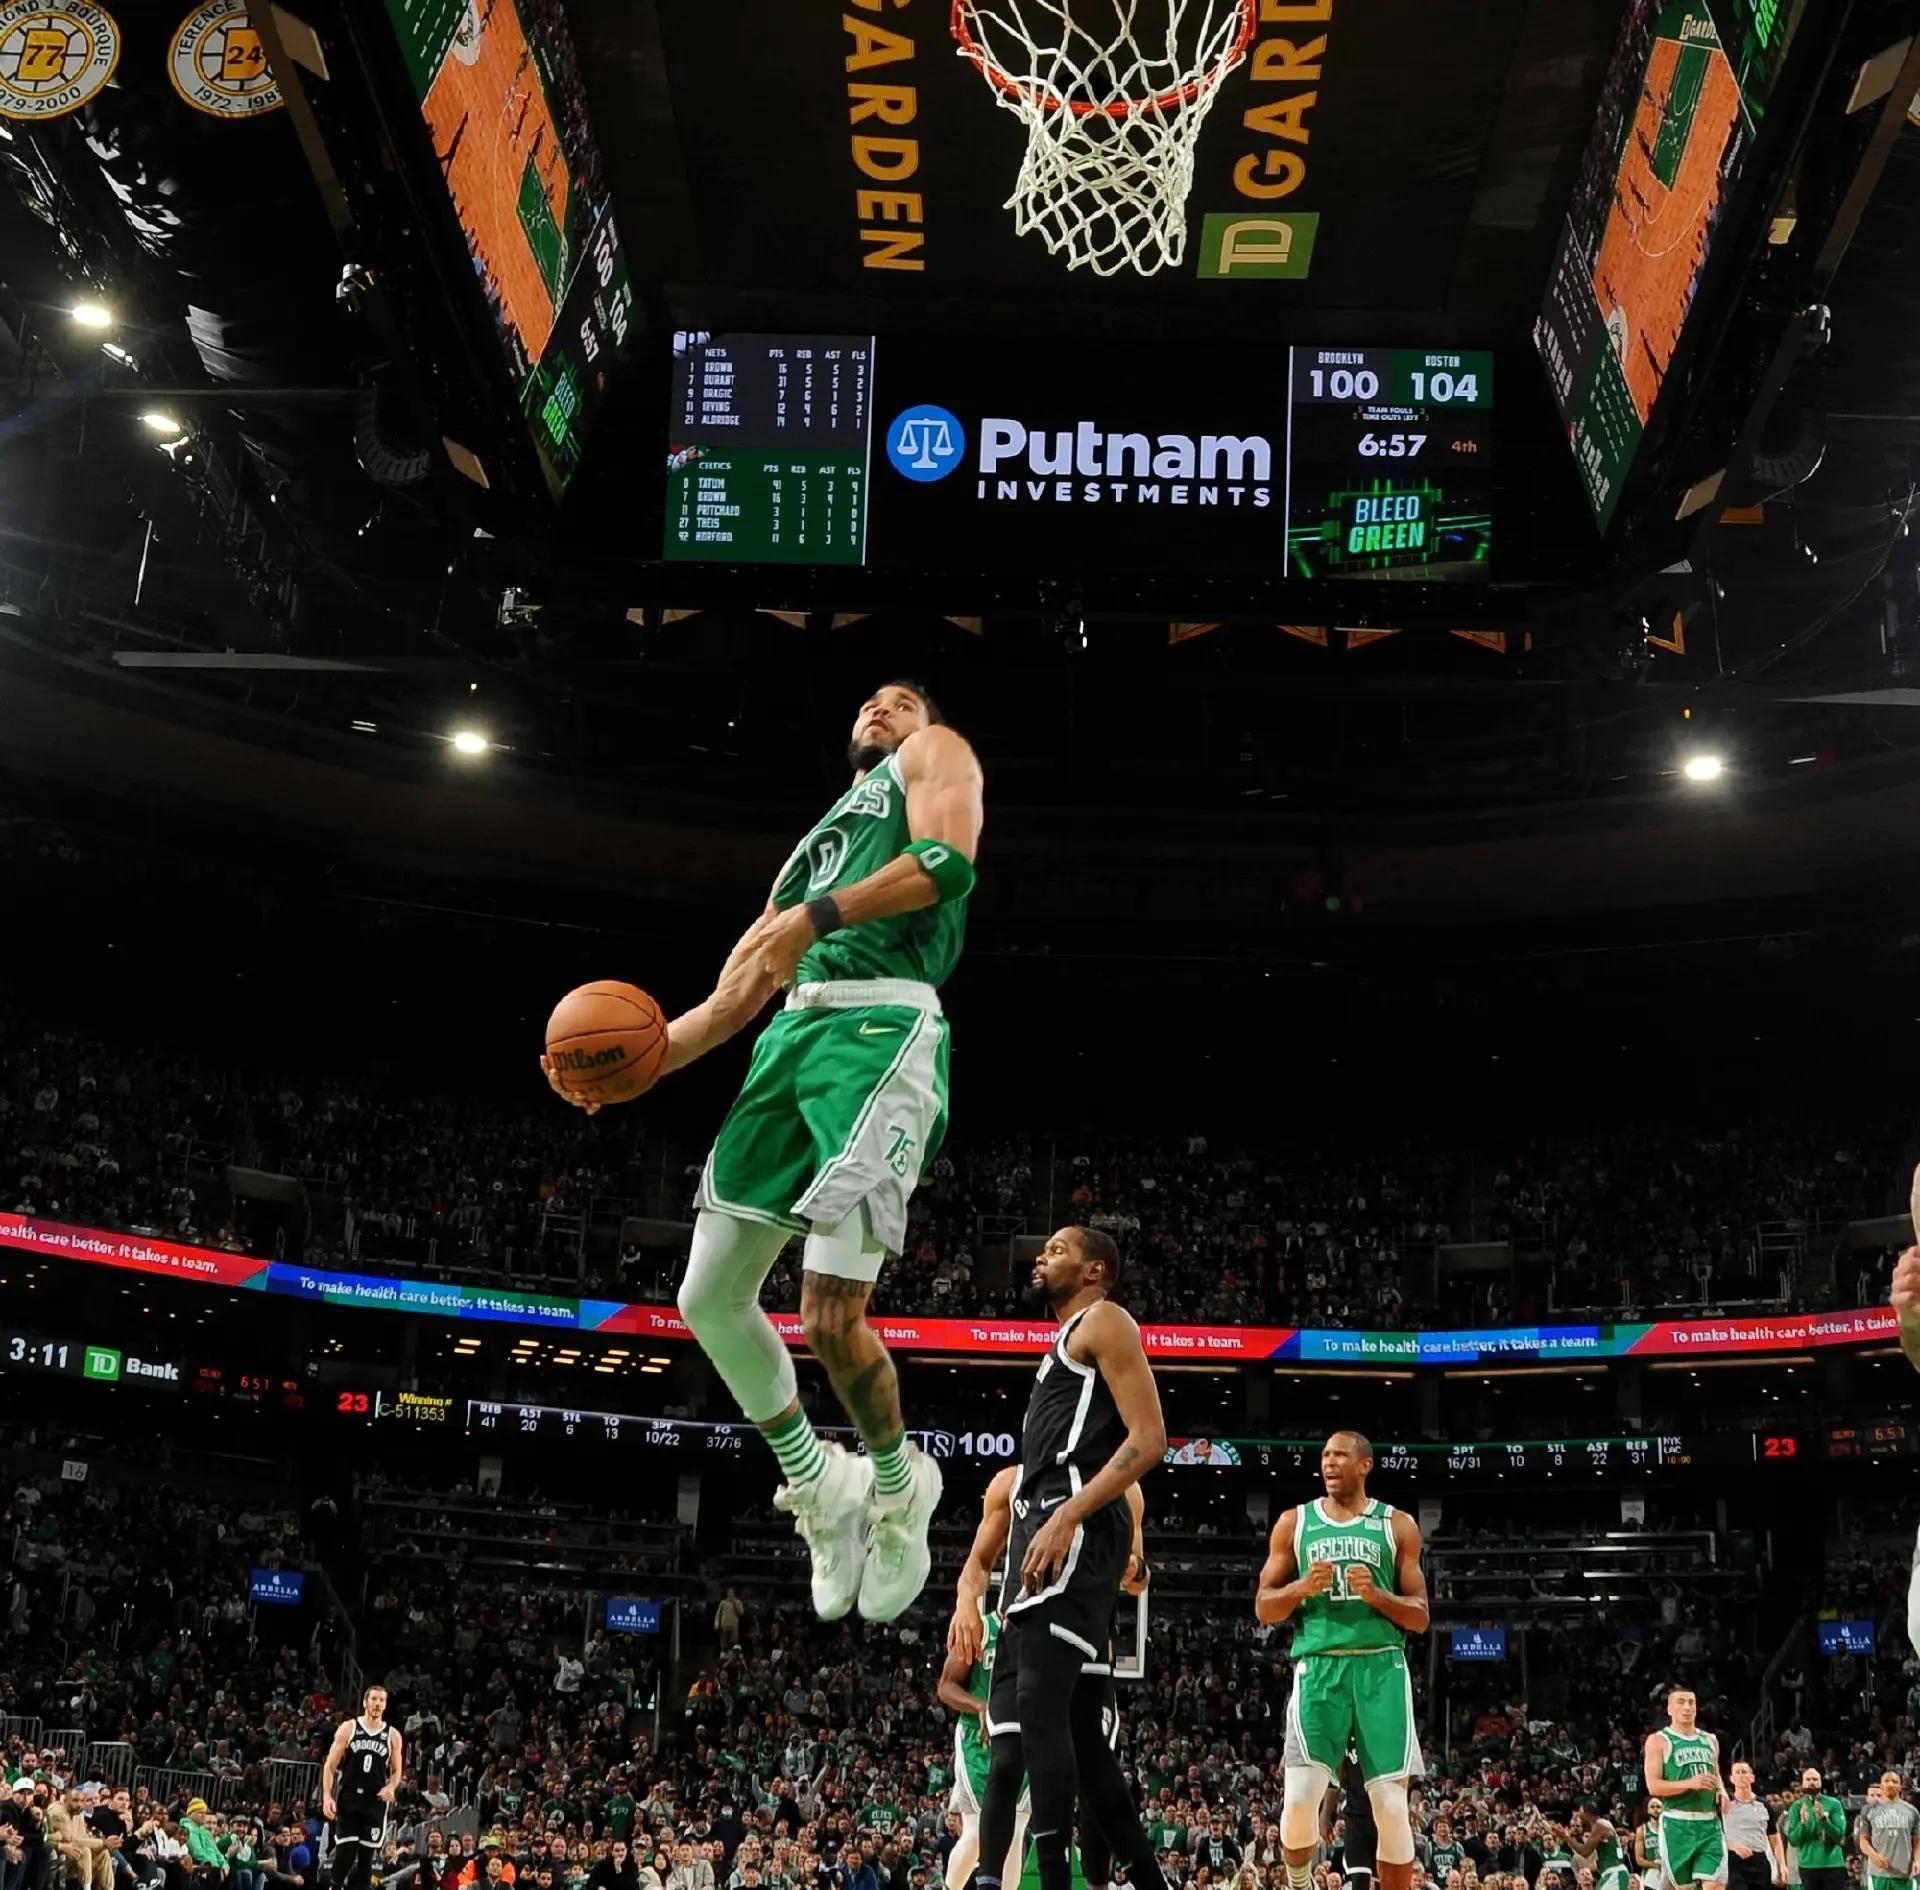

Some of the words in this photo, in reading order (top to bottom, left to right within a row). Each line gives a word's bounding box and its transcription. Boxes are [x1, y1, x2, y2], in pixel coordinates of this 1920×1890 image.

[66, 1, 111, 66] BOURQUE
[177, 0, 236, 58] TERENCE
[26, 45, 63, 66] 77
[227, 46, 262, 64] 24
[194, 86, 231, 109] 1972
[842, 0, 924, 271] ARDEN
[1218, 219, 1293, 274] TD
[705, 349, 726, 357] NETS
[825, 351, 840, 359] AST
[852, 351, 866, 359] FLS
[1318, 352, 1364, 365] BROOKLYN
[1425, 356, 1460, 368] BOSTON
[705, 362, 732, 372] BROWN
[704, 375, 736, 385] DURANT
[1310, 370, 1379, 400] 100
[1411, 373, 1478, 402] 104
[703, 389, 732, 398] DRAGIC
[702, 402, 730, 411] IRVING
[685, 415, 693, 424] 21
[979, 418, 1271, 481] Putnam
[1358, 434, 1427, 457] 6:57
[1451, 440, 1477, 453] 4th
[698, 478, 725, 488] TATUM
[697, 492, 726, 501] BROWN
[977, 480, 1271, 507] INVESTMENTS
[697, 506, 740, 516] PRITCHARD
[1355, 496, 1419, 523] BLEED
[679, 518, 689, 527] 27
[697, 518, 719, 528] THEIS
[1348, 522, 1425, 553] GREEN
[0, 1224, 36, 1240] ealth
[39, 1233, 69, 1247] care
[71, 1235, 116, 1257] better,
[131, 1246, 168, 1265] takes
[182, 1256, 219, 1274] team.
[300, 1277, 315, 1290] To
[319, 1281, 352, 1296] make
[355, 1284, 397, 1300] health
[400, 1290, 428, 1304] care
[431, 1291, 473, 1309] better,
[490, 1298, 525, 1314] takes
[538, 1304, 575, 1319] team.
[651, 1316, 664, 1328] To
[883, 1327, 920, 1339] team.
[1671, 1330, 1688, 1343] To
[1691, 1328, 1729, 1343] make
[1730, 1325, 1775, 1341] health
[1777, 1328, 1806, 1340] care
[1808, 1321, 1852, 1337] better,
[1867, 1316, 1898, 1330] take
[971, 1328, 987, 1341] To
[991, 1329, 1025, 1342] make
[1159, 1334, 1194, 1348] takes
[1208, 1336, 1244, 1349] team.
[1324, 1339, 1339, 1351] To
[1343, 1339, 1377, 1352] make
[1379, 1339, 1420, 1353] health
[1423, 1344, 1451, 1353] care
[1511, 1336, 1547, 1351] takes
[1561, 1336, 1598, 1348] team.
[9, 1337, 68, 1369] 3:11
[87, 1351, 118, 1374] TD
[126, 1357, 179, 1381] Bank
[338, 1393, 368, 1412] 23
[399, 1392, 442, 1405] Winning
[377, 1402, 446, 1422] C-511353
[480, 1404, 502, 1414] REB
[519, 1408, 542, 1419] AST
[562, 1411, 581, 1423] STL
[603, 1416, 619, 1427] TO
[715, 1425, 731, 1434] FG
[481, 1416, 496, 1428] 41
[521, 1420, 537, 1432] 20
[566, 1425, 574, 1435] 6
[605, 1427, 618, 1439] 13
[645, 1431, 680, 1446] 10/22
[706, 1436, 741, 1449] 37/76
[1664, 1437, 1681, 1446] NYK
[959, 1432, 1015, 1457] 100
[1453, 1446, 1475, 1454] 3PT
[1506, 1445, 1523, 1453] TO
[1548, 1444, 1567, 1453] STL
[1587, 1442, 1609, 1451] AST
[1626, 1441, 1648, 1451] REB
[1664, 1445, 1682, 1455] LAC
[1764, 1438, 1798, 1457] 23
[1261, 1454, 1268, 1465] 3
[1294, 1455, 1301, 1466] 2
[1381, 1457, 1418, 1470] 35/72
[1510, 1455, 1524, 1467] 10
[1555, 1454, 1563, 1465] 8
[1592, 1453, 1606, 1465] 22
[1306, 1537, 1381, 1568] CELTICS
[350, 1740, 388, 1757] BROOKLYN
